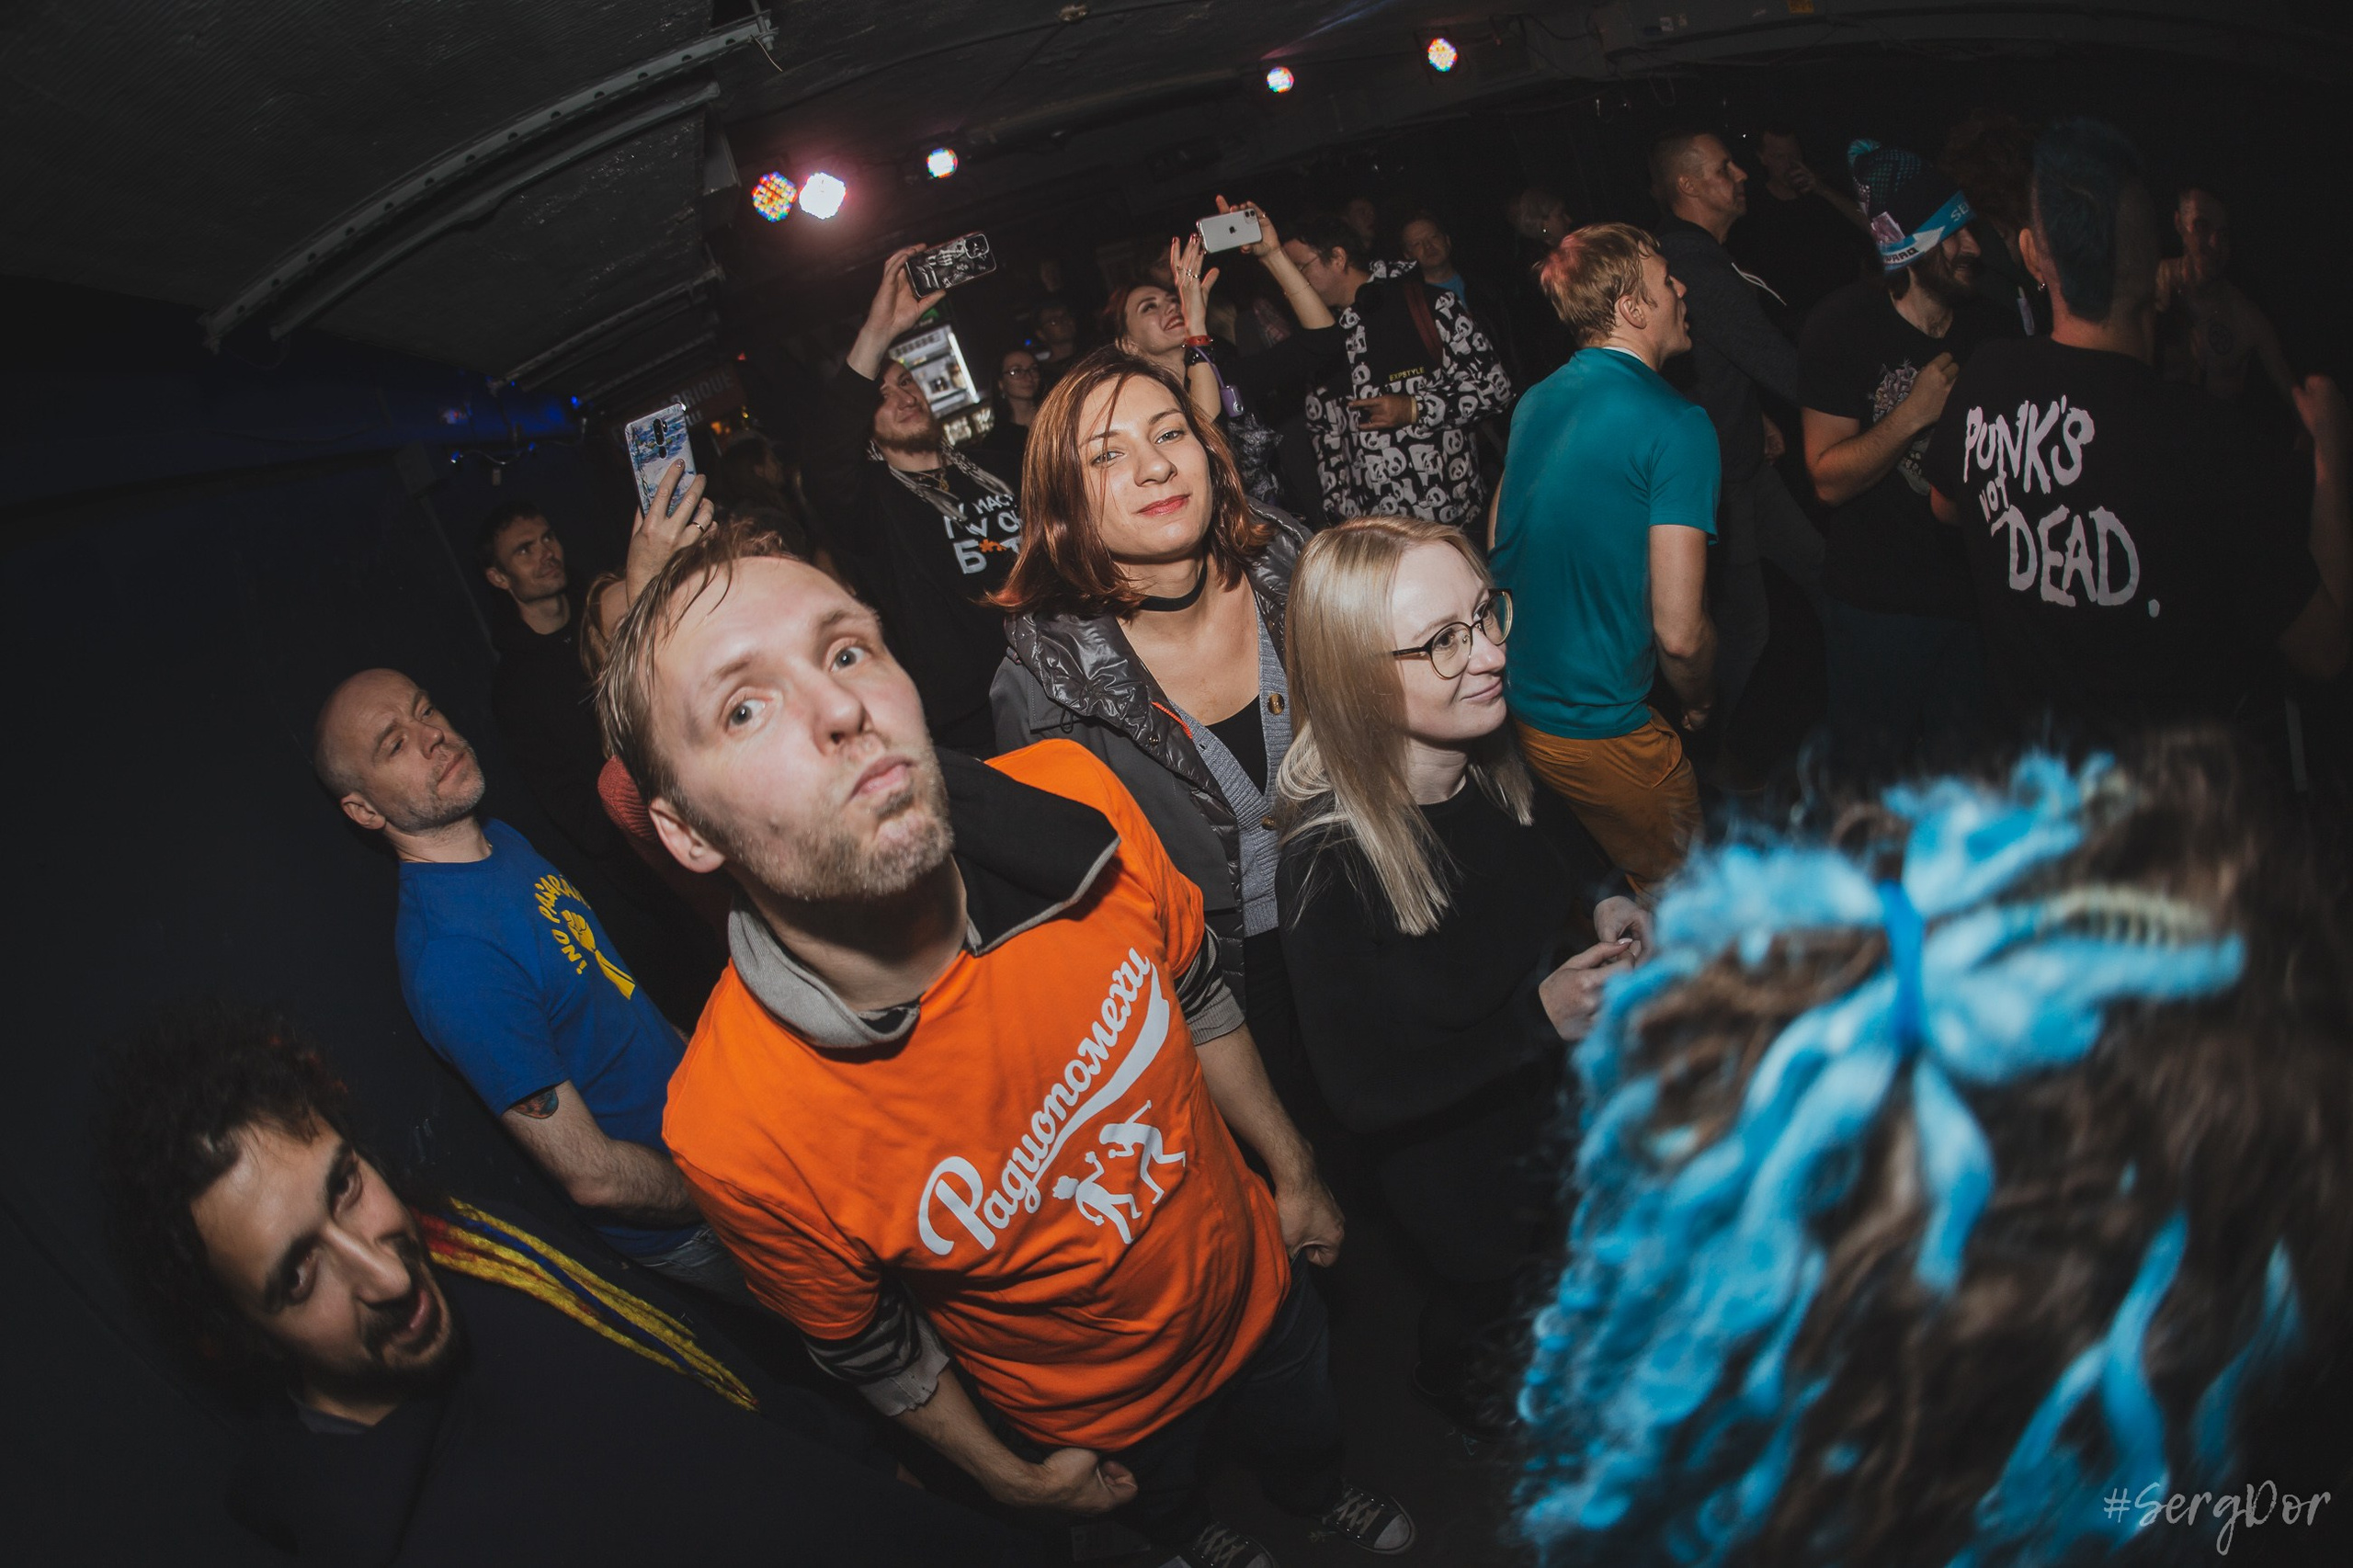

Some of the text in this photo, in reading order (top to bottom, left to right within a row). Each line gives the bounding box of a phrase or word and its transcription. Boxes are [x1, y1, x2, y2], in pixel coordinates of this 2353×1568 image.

[1963, 394, 2096, 494] PUNK'S
[1979, 470, 2009, 523] NOT
[1990, 504, 2161, 619] DEAD.
[918, 947, 1152, 1256] Радиопомехи
